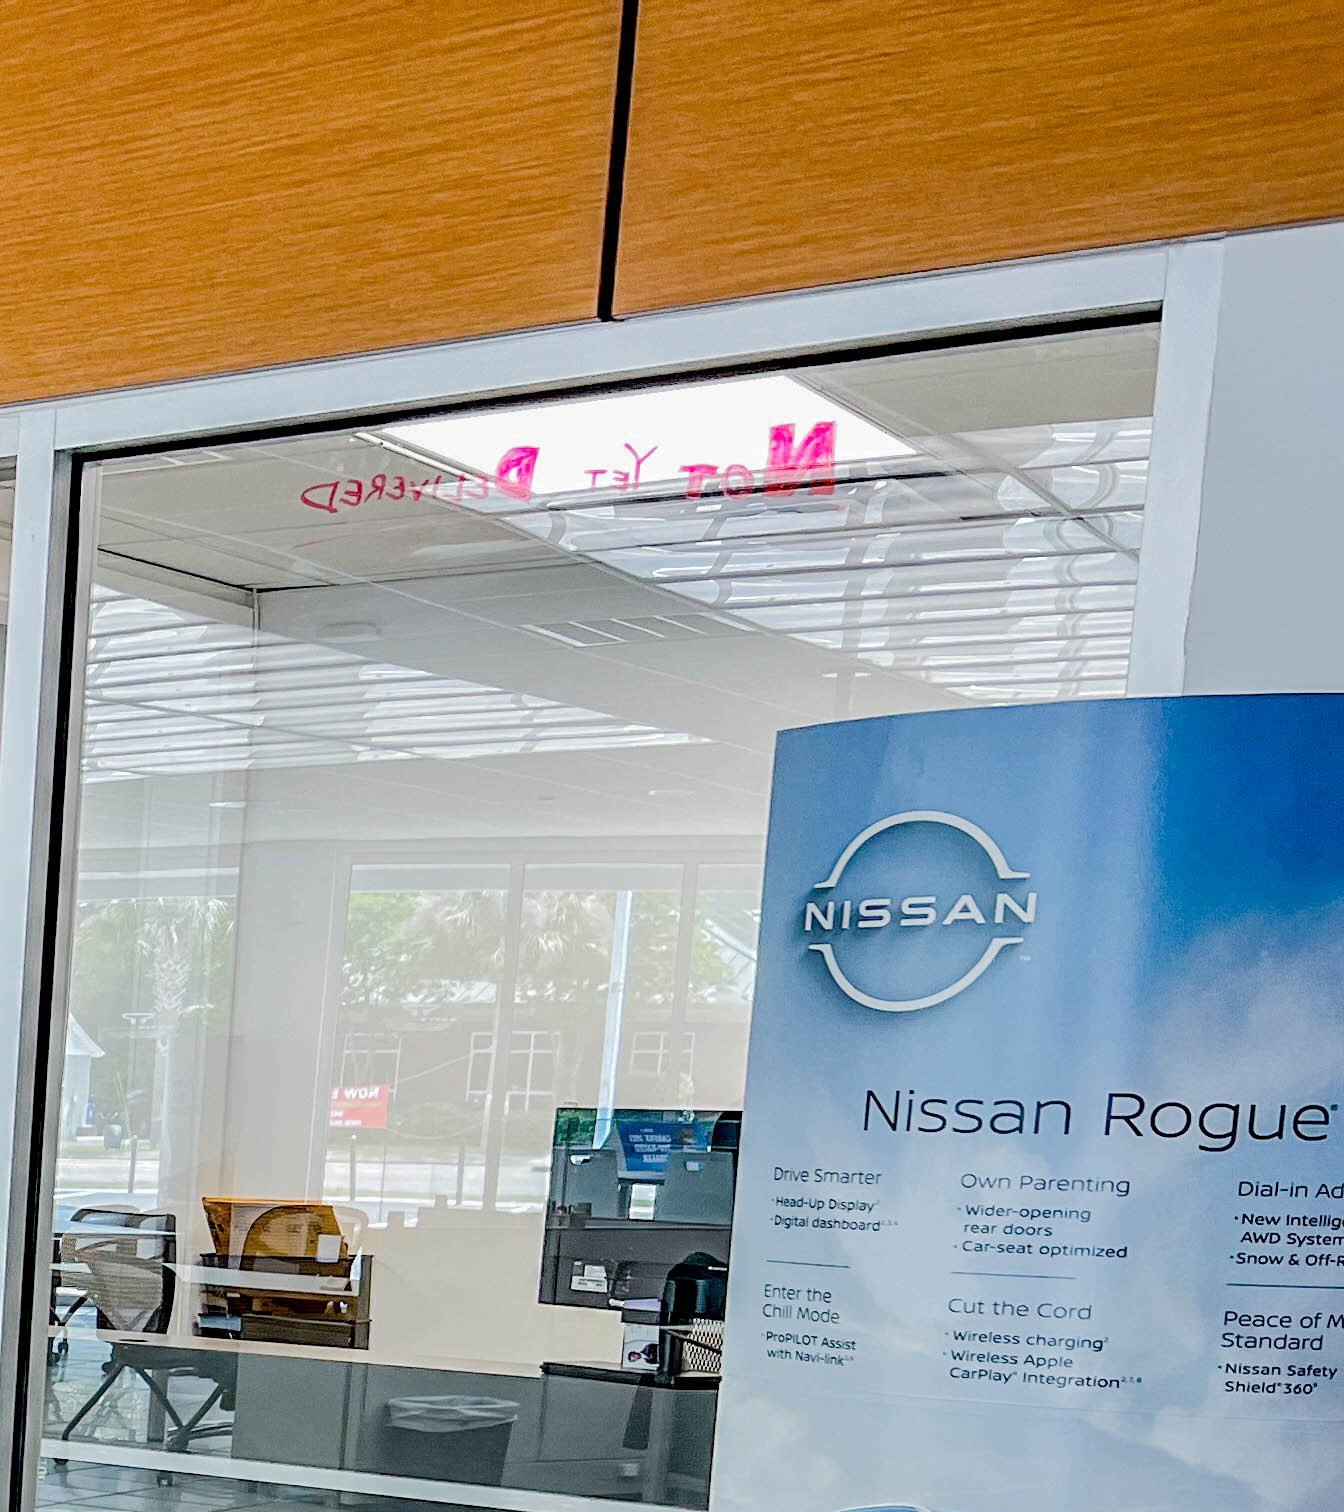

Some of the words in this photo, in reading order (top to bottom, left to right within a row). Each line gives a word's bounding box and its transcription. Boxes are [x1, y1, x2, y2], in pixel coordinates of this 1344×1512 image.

[805, 892, 1038, 931] NISSAN
[863, 1089, 1072, 1135] Nissan
[1104, 1091, 1332, 1153] Rogue
[773, 1167, 810, 1182] Drive
[813, 1168, 882, 1185] Smarter
[960, 1173, 1011, 1189] Own
[1019, 1175, 1131, 1197] Parenting
[1238, 1180, 1309, 1198] Dial-in
[775, 1196, 825, 1211] Head-Up
[773, 1214, 809, 1229] Digital
[811, 1216, 881, 1232] dashboard
[965, 1204, 1092, 1223] Wider-opening
[1241, 1213, 1281, 1226] New
[1285, 1214, 1344, 1231] Intellig
[963, 1222, 997, 1234] rear
[1003, 1223, 1054, 1237] doors
[1240, 1231, 1281, 1245] AWD
[961, 1240, 1033, 1255] Car-seat
[1039, 1245, 1128, 1259] optimized
[1235, 1252, 1283, 1265] Snow
[1288, 1253, 1299, 1266] &
[763, 1283, 802, 1300] Enter
[806, 1287, 832, 1304] the
[762, 1303, 792, 1319] Chill
[796, 1306, 840, 1324] Mode
[947, 1298, 985, 1315] Cut
[992, 1301, 1030, 1317] the
[1036, 1303, 1093, 1320] Cord
[1223, 1310, 1293, 1328] Peace
[1299, 1312, 1323, 1329] of
[766, 1331, 818, 1346] ProPILOT
[821, 1337, 857, 1351] Assist
[953, 1330, 1021, 1345] Wireless
[1220, 1332, 1324, 1351] Standard
[767, 1348, 792, 1360] with
[951, 1351, 1019, 1365] Wireless
[1023, 1354, 1074, 1370] Apple
[1224, 1363, 1281, 1376] Nissan
[1286, 1364, 1338, 1380] Safety
